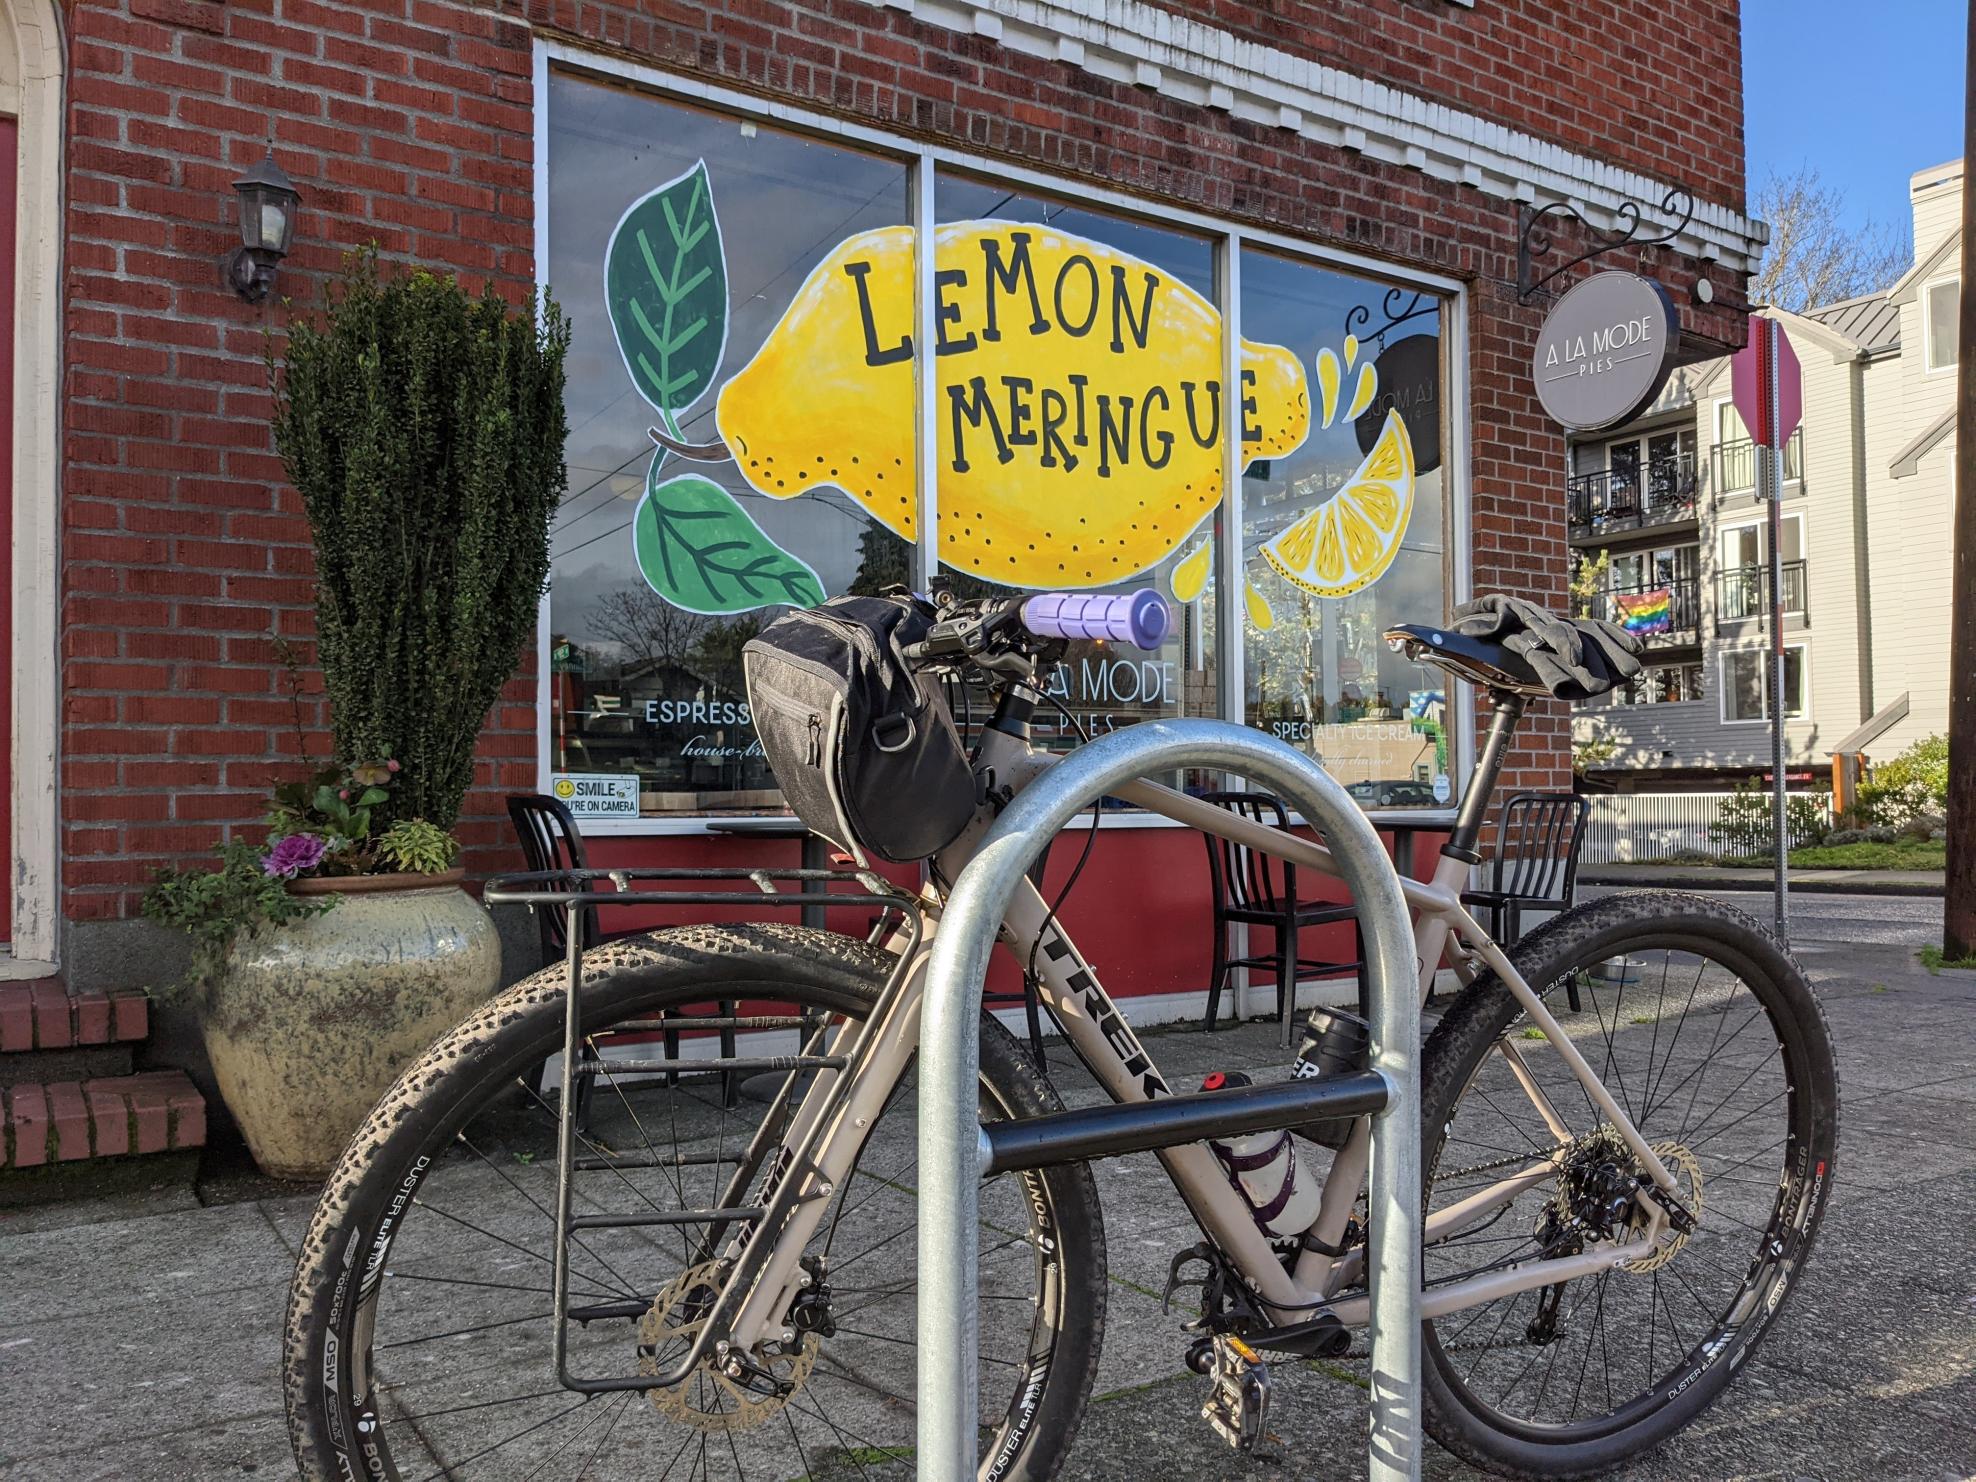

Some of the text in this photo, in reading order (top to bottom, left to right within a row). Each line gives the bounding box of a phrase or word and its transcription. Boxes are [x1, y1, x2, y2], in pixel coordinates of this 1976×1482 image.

[844, 232, 1159, 367] LEMON
[1546, 316, 1651, 368] A LA MODE
[1580, 357, 1612, 376] PIES
[947, 369, 1262, 478] MERINGUE
[1040, 658, 1176, 703] A MODE
[646, 700, 751, 724] ESPRESS
[1273, 721, 1425, 741] SPECIALTY ICE CREAM
[680, 735, 767, 760] house-br
[576, 782, 616, 796] SMILE
[562, 800, 635, 812] U'RE ON CAMERA
[1043, 918, 1170, 1100] TREK
[387, 1155, 431, 1216] DUSTER
[1780, 1146, 1808, 1239] BONTRAGER
[374, 1217, 393, 1249] ELITE
[1769, 1280, 1786, 1307] MSO
[326, 1340, 337, 1382] MSO
[352, 1393, 362, 1407] 29
[1667, 1368, 1702, 1400] DUSTER
[986, 1429, 1024, 1482] DUSTER
[1019, 1400, 1036, 1430] ELITE
